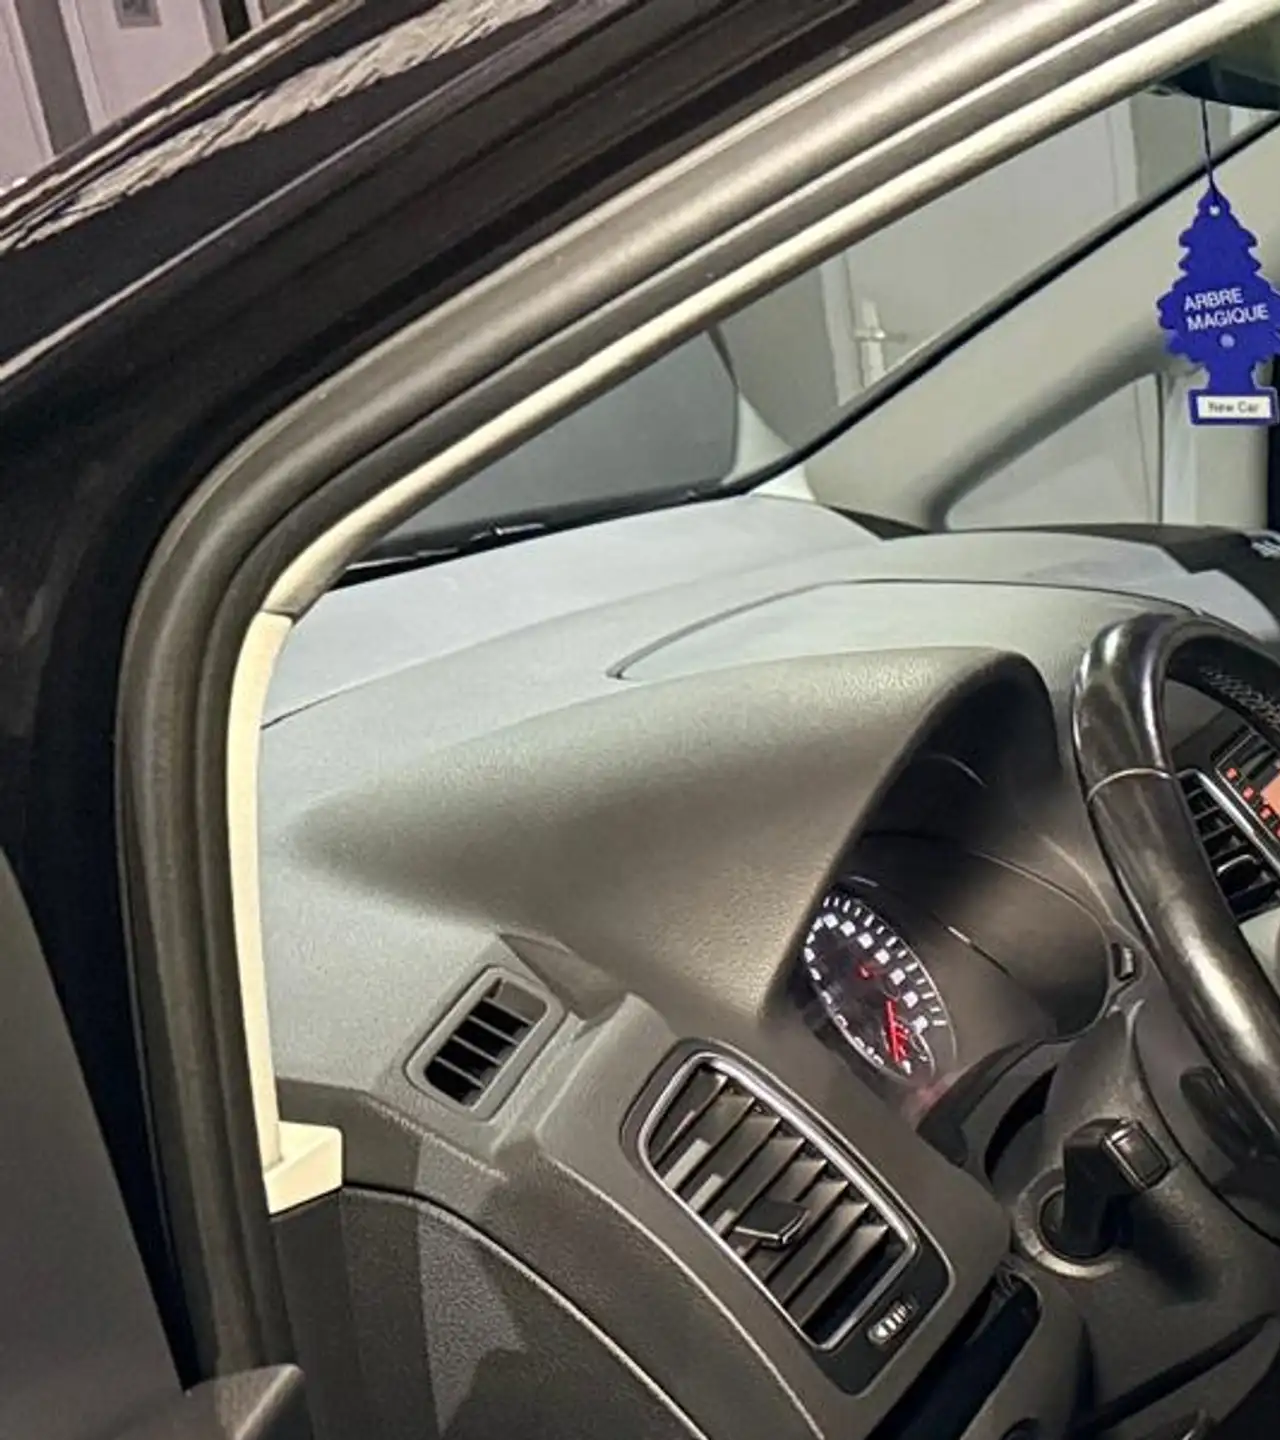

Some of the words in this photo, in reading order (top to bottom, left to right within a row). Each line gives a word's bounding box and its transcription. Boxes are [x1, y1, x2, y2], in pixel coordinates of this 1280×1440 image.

[1183, 287, 1244, 313] ARBRE
[1186, 303, 1270, 332] MAGIQUE
[1207, 401, 1235, 413] New
[1238, 400, 1260, 413] Car
